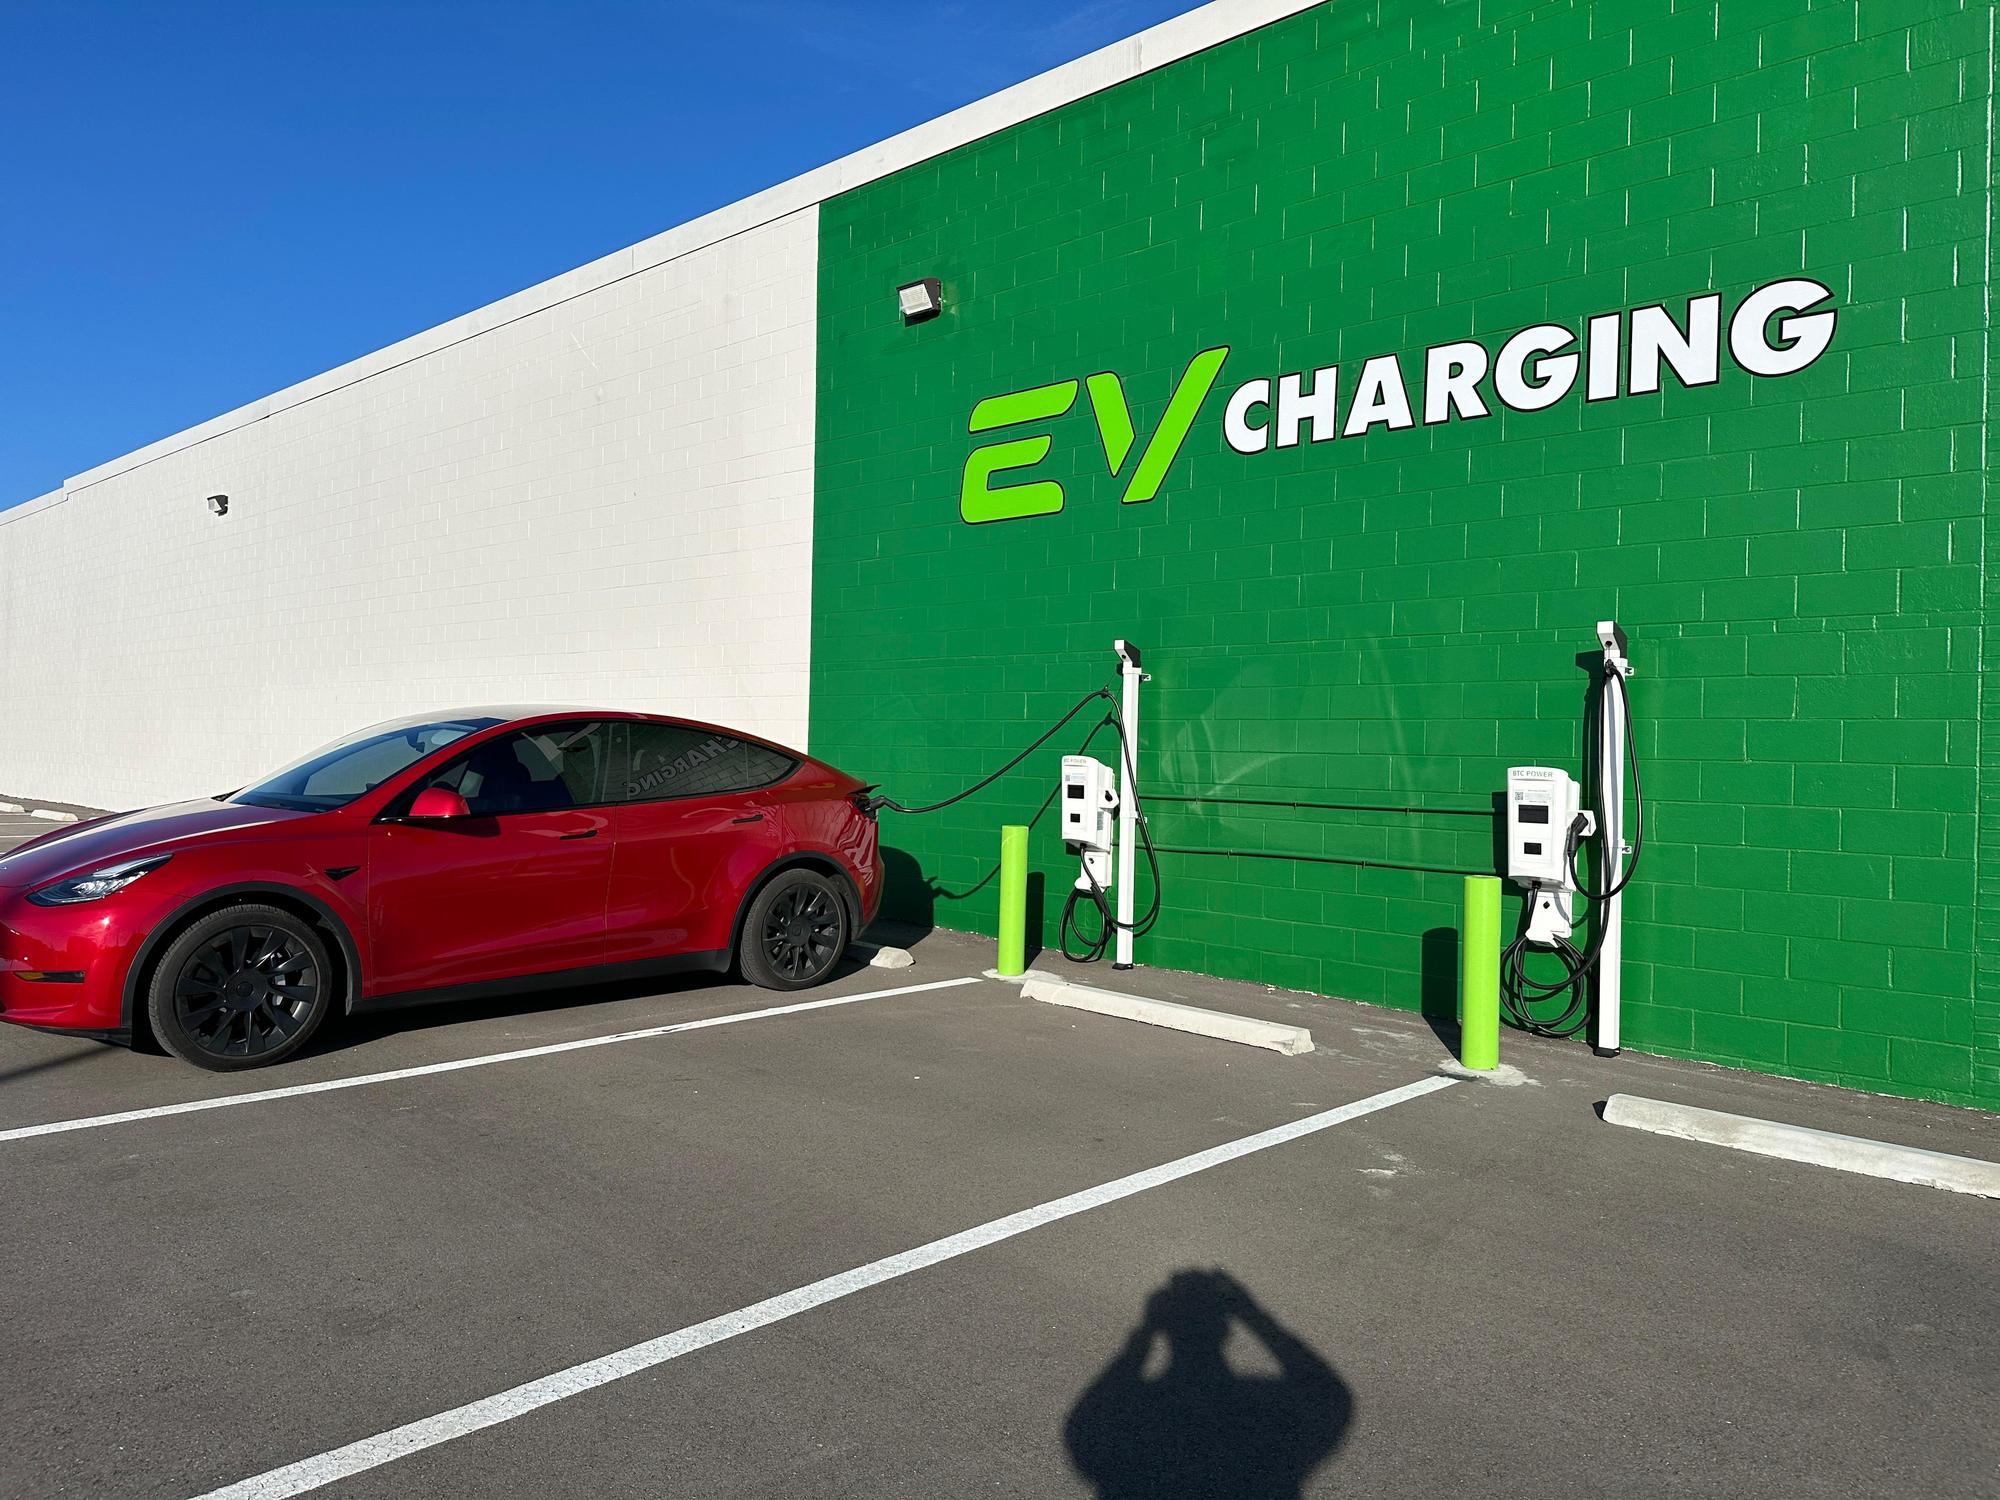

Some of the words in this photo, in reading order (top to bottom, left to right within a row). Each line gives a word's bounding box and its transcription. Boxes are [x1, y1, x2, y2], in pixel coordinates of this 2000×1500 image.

[959, 346, 1230, 524] EV
[1223, 278, 1837, 455] CHARGING
[1526, 770, 1553, 778] POWER
